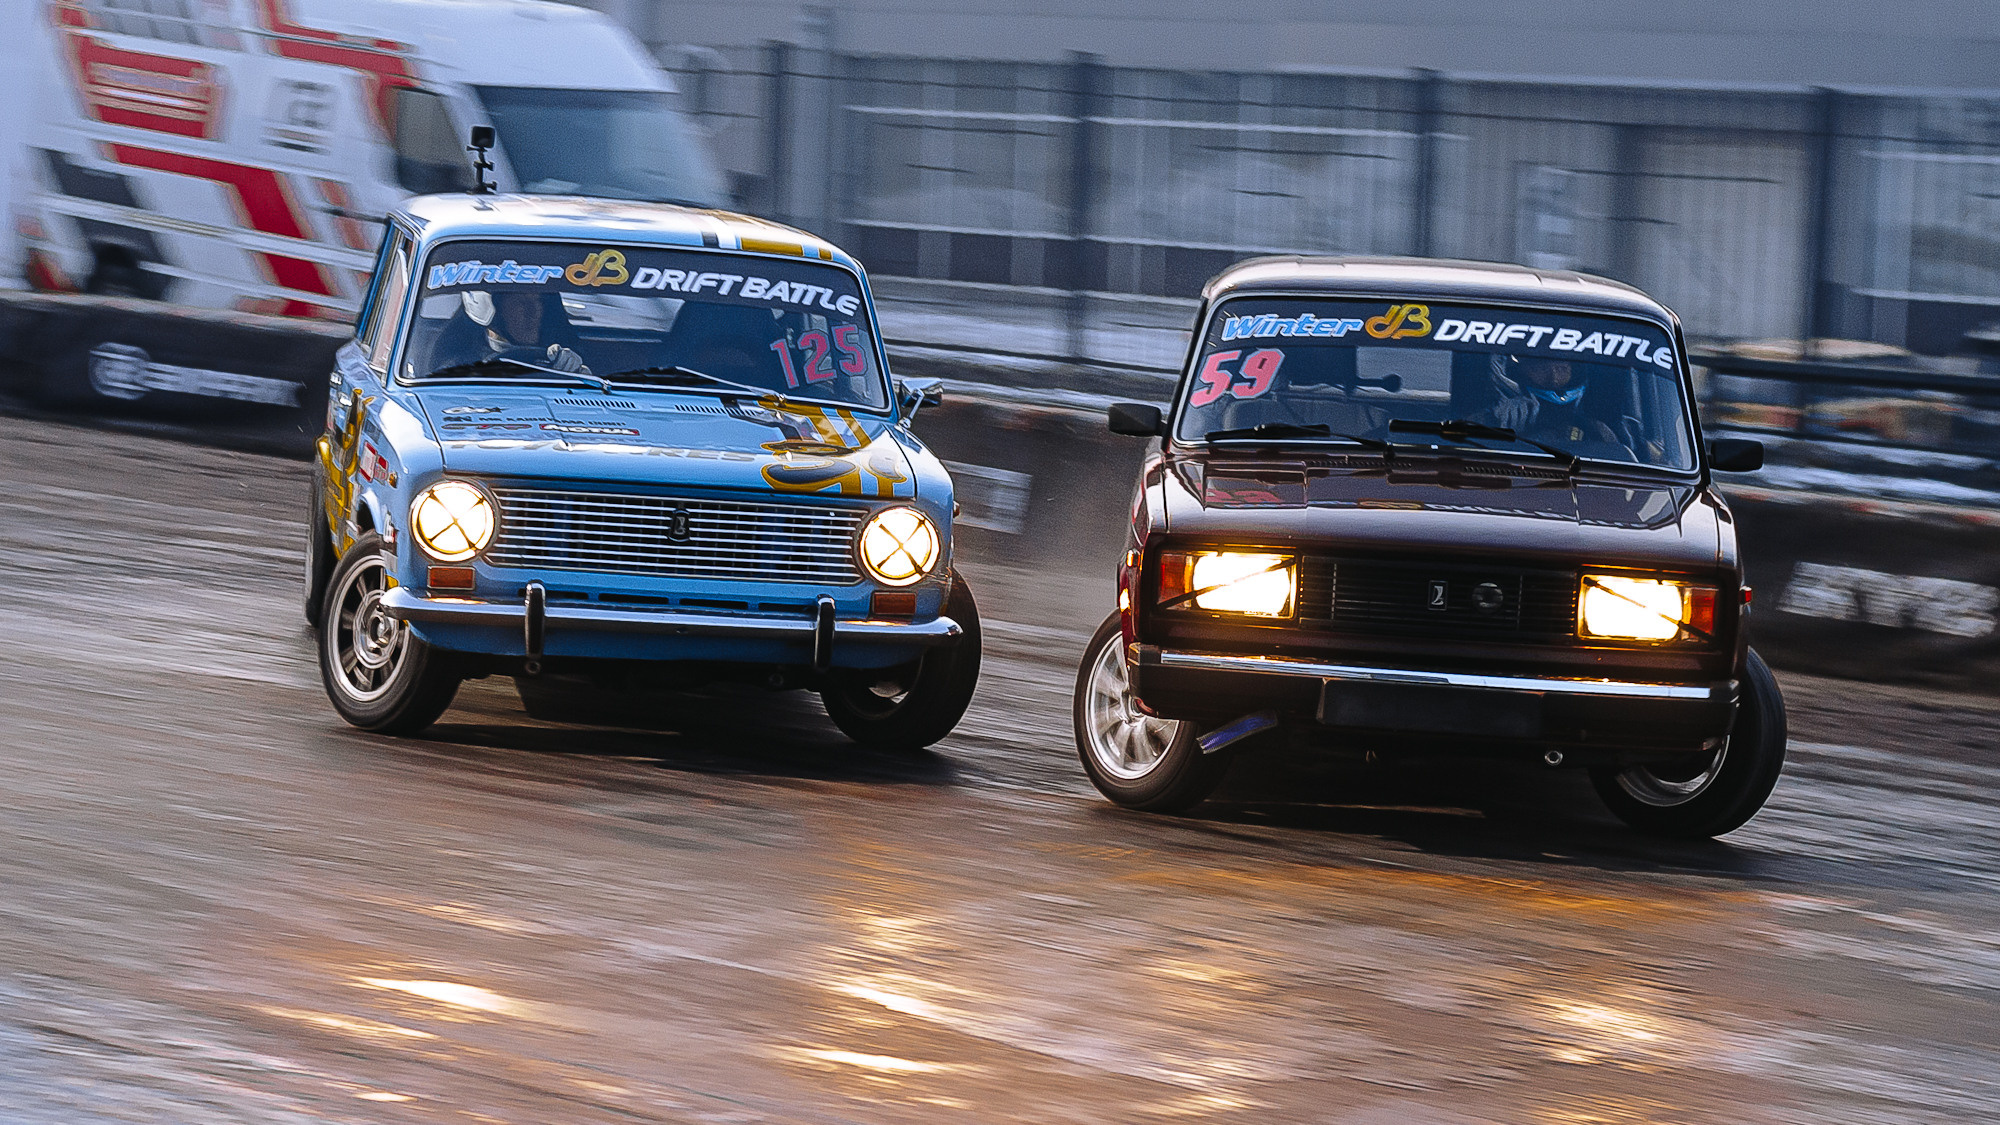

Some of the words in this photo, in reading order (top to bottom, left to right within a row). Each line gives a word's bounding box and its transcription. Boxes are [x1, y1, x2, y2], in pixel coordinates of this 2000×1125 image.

[427, 260, 564, 291] Winter
[631, 267, 742, 296] DRIFT
[739, 276, 861, 317] BATTLE
[769, 322, 869, 389] 125
[1221, 313, 1364, 342] Winter
[1433, 319, 1555, 349] DRIFT
[1549, 330, 1674, 370] BATTLE
[1190, 349, 1286, 408] 59
[542, 423, 636, 435] MOTUL
